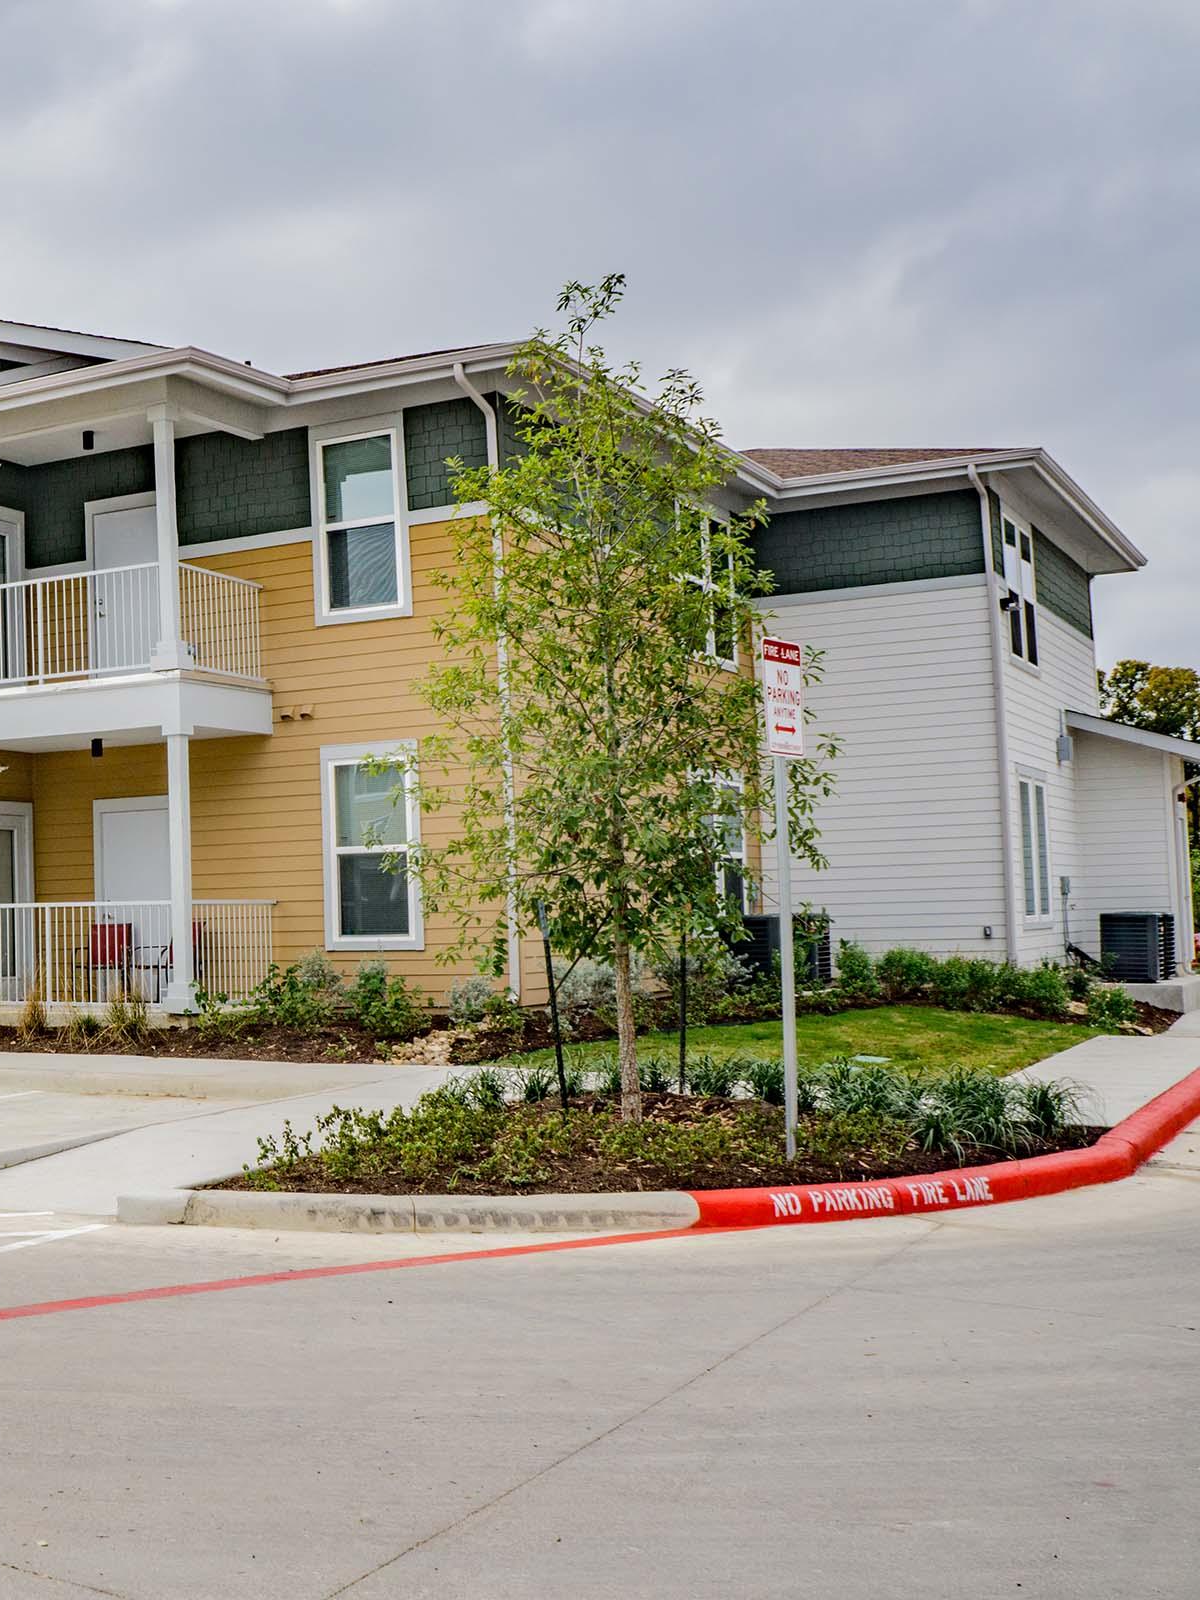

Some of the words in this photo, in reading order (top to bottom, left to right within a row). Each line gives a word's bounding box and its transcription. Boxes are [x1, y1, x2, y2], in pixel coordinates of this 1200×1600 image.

[764, 644, 779, 658] FIRE
[781, 648, 799, 661] LANE
[776, 669, 788, 686] NO
[767, 686, 800, 706] PARKING
[774, 706, 796, 720] ANYTIME
[769, 1193, 802, 1217] NO
[808, 1186, 894, 1213] PARKING
[905, 1181, 949, 1206] FIRE
[949, 1176, 994, 1201] LANE
